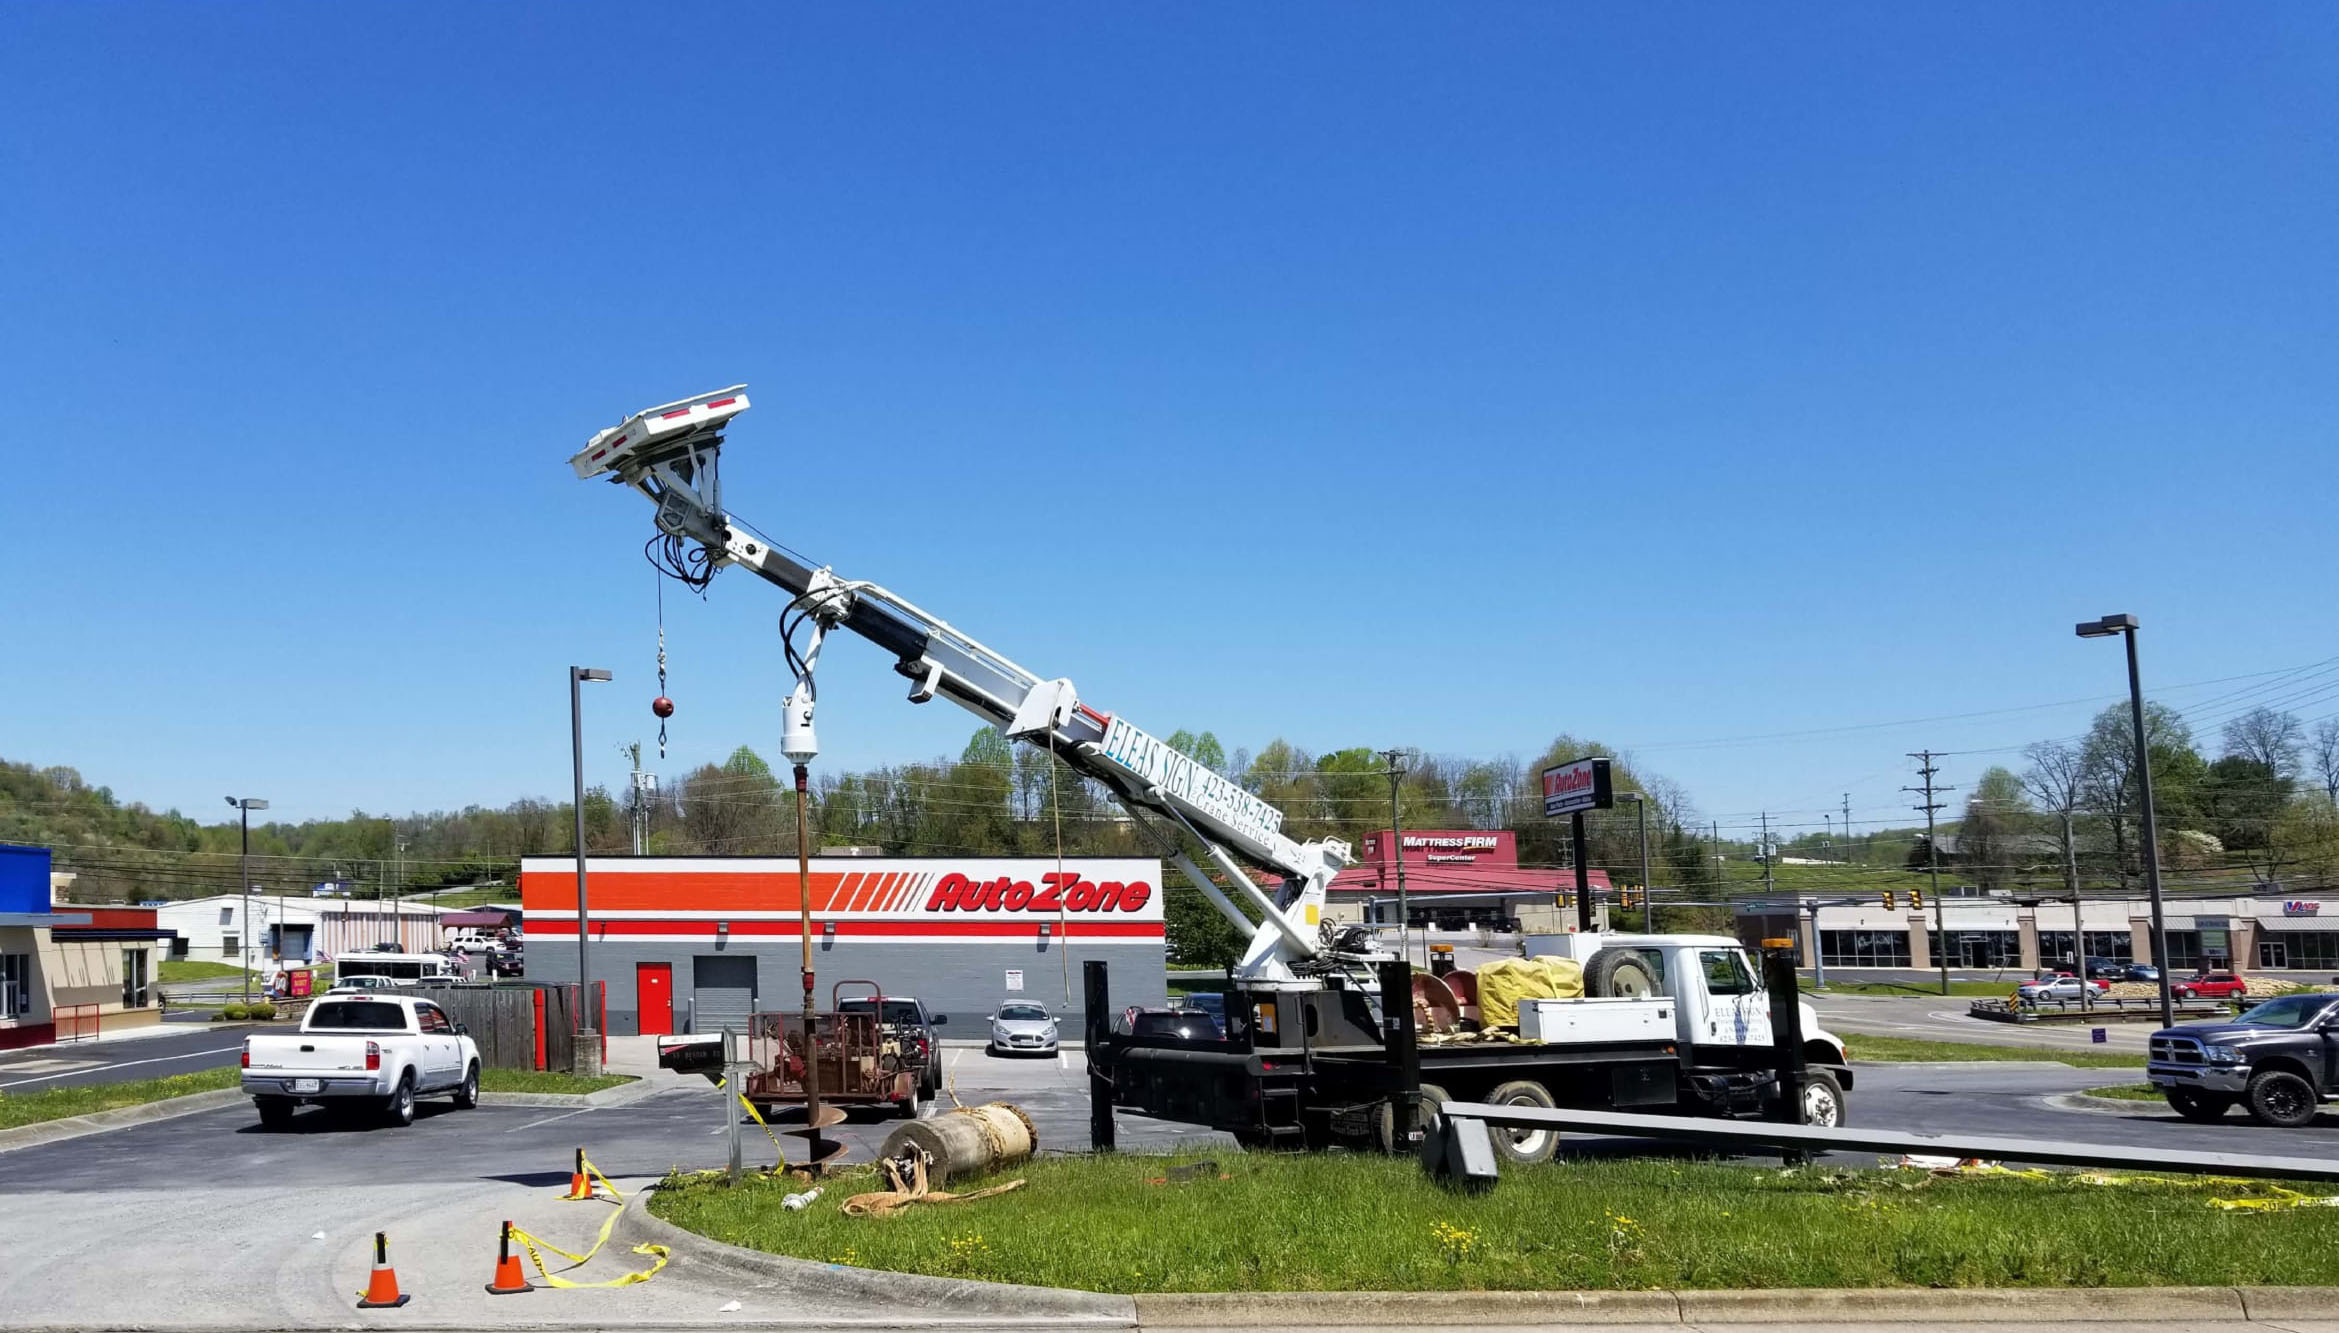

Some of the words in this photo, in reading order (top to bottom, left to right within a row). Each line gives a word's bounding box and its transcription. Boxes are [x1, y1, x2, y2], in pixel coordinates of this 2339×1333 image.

[1106, 719, 1160, 779] ELEAS
[1158, 750, 1199, 800] SIGN
[1554, 767, 1592, 794] AutoZone
[1195, 792, 1228, 823] Crane
[1231, 813, 1270, 846] Service
[1201, 774, 1282, 835] 423-538-7425
[925, 872, 1151, 912] AutoZone
[1720, 1034, 1765, 1043] 423--7425
